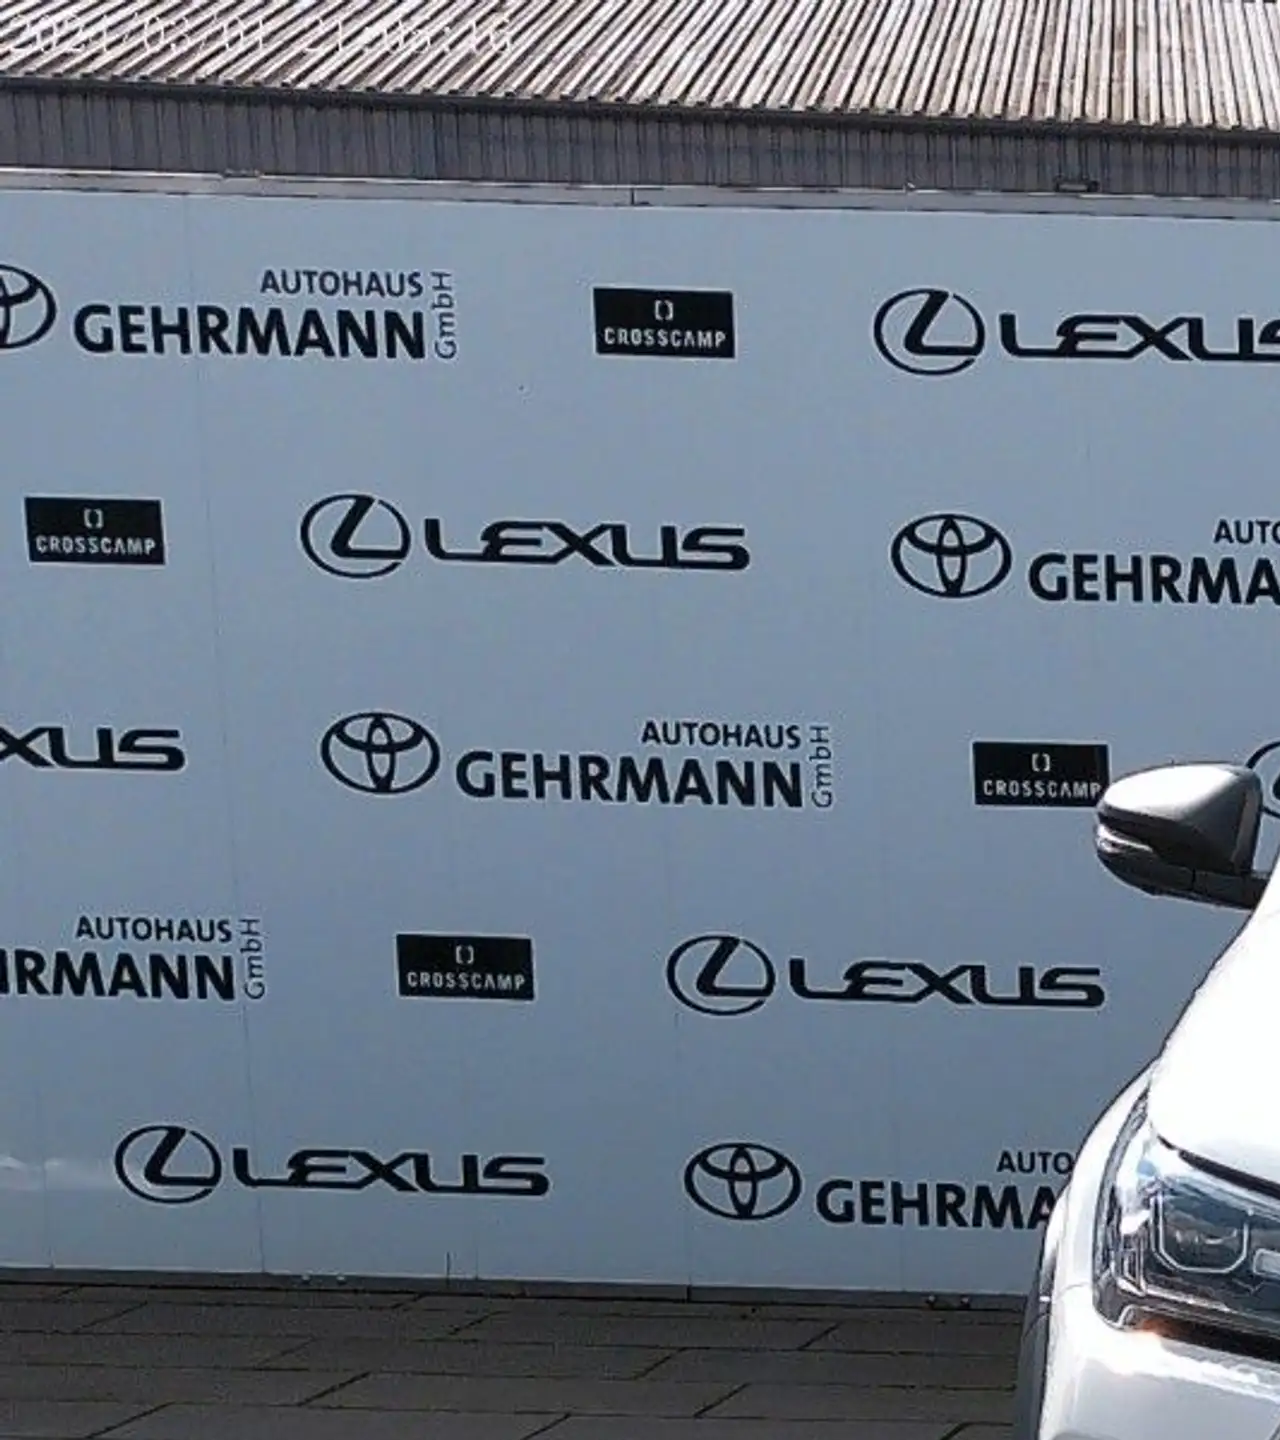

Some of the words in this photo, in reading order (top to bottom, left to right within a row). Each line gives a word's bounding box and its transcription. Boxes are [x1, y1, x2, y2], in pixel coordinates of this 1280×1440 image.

[260, 270, 423, 298] AUTOHAUS
[74, 304, 425, 359] GEHRMANN
[430, 272, 456, 359] GmbH
[605, 328, 725, 347] CROSSCAMP
[36, 536, 155, 554] CROSSCAMP
[425, 519, 750, 570] LEXUS
[641, 721, 801, 750] AUTOHAUS
[456, 748, 802, 807] GEHRMANN
[809, 726, 832, 808] GmbH
[983, 780, 1100, 799] CROSSCAMP
[76, 916, 232, 943] AUTOHAUS
[239, 919, 265, 999] GmbH
[408, 972, 525, 989] CROSSCAMP
[789, 959, 1104, 1008] LEXUS
[233, 1148, 549, 1196] LEXUS
